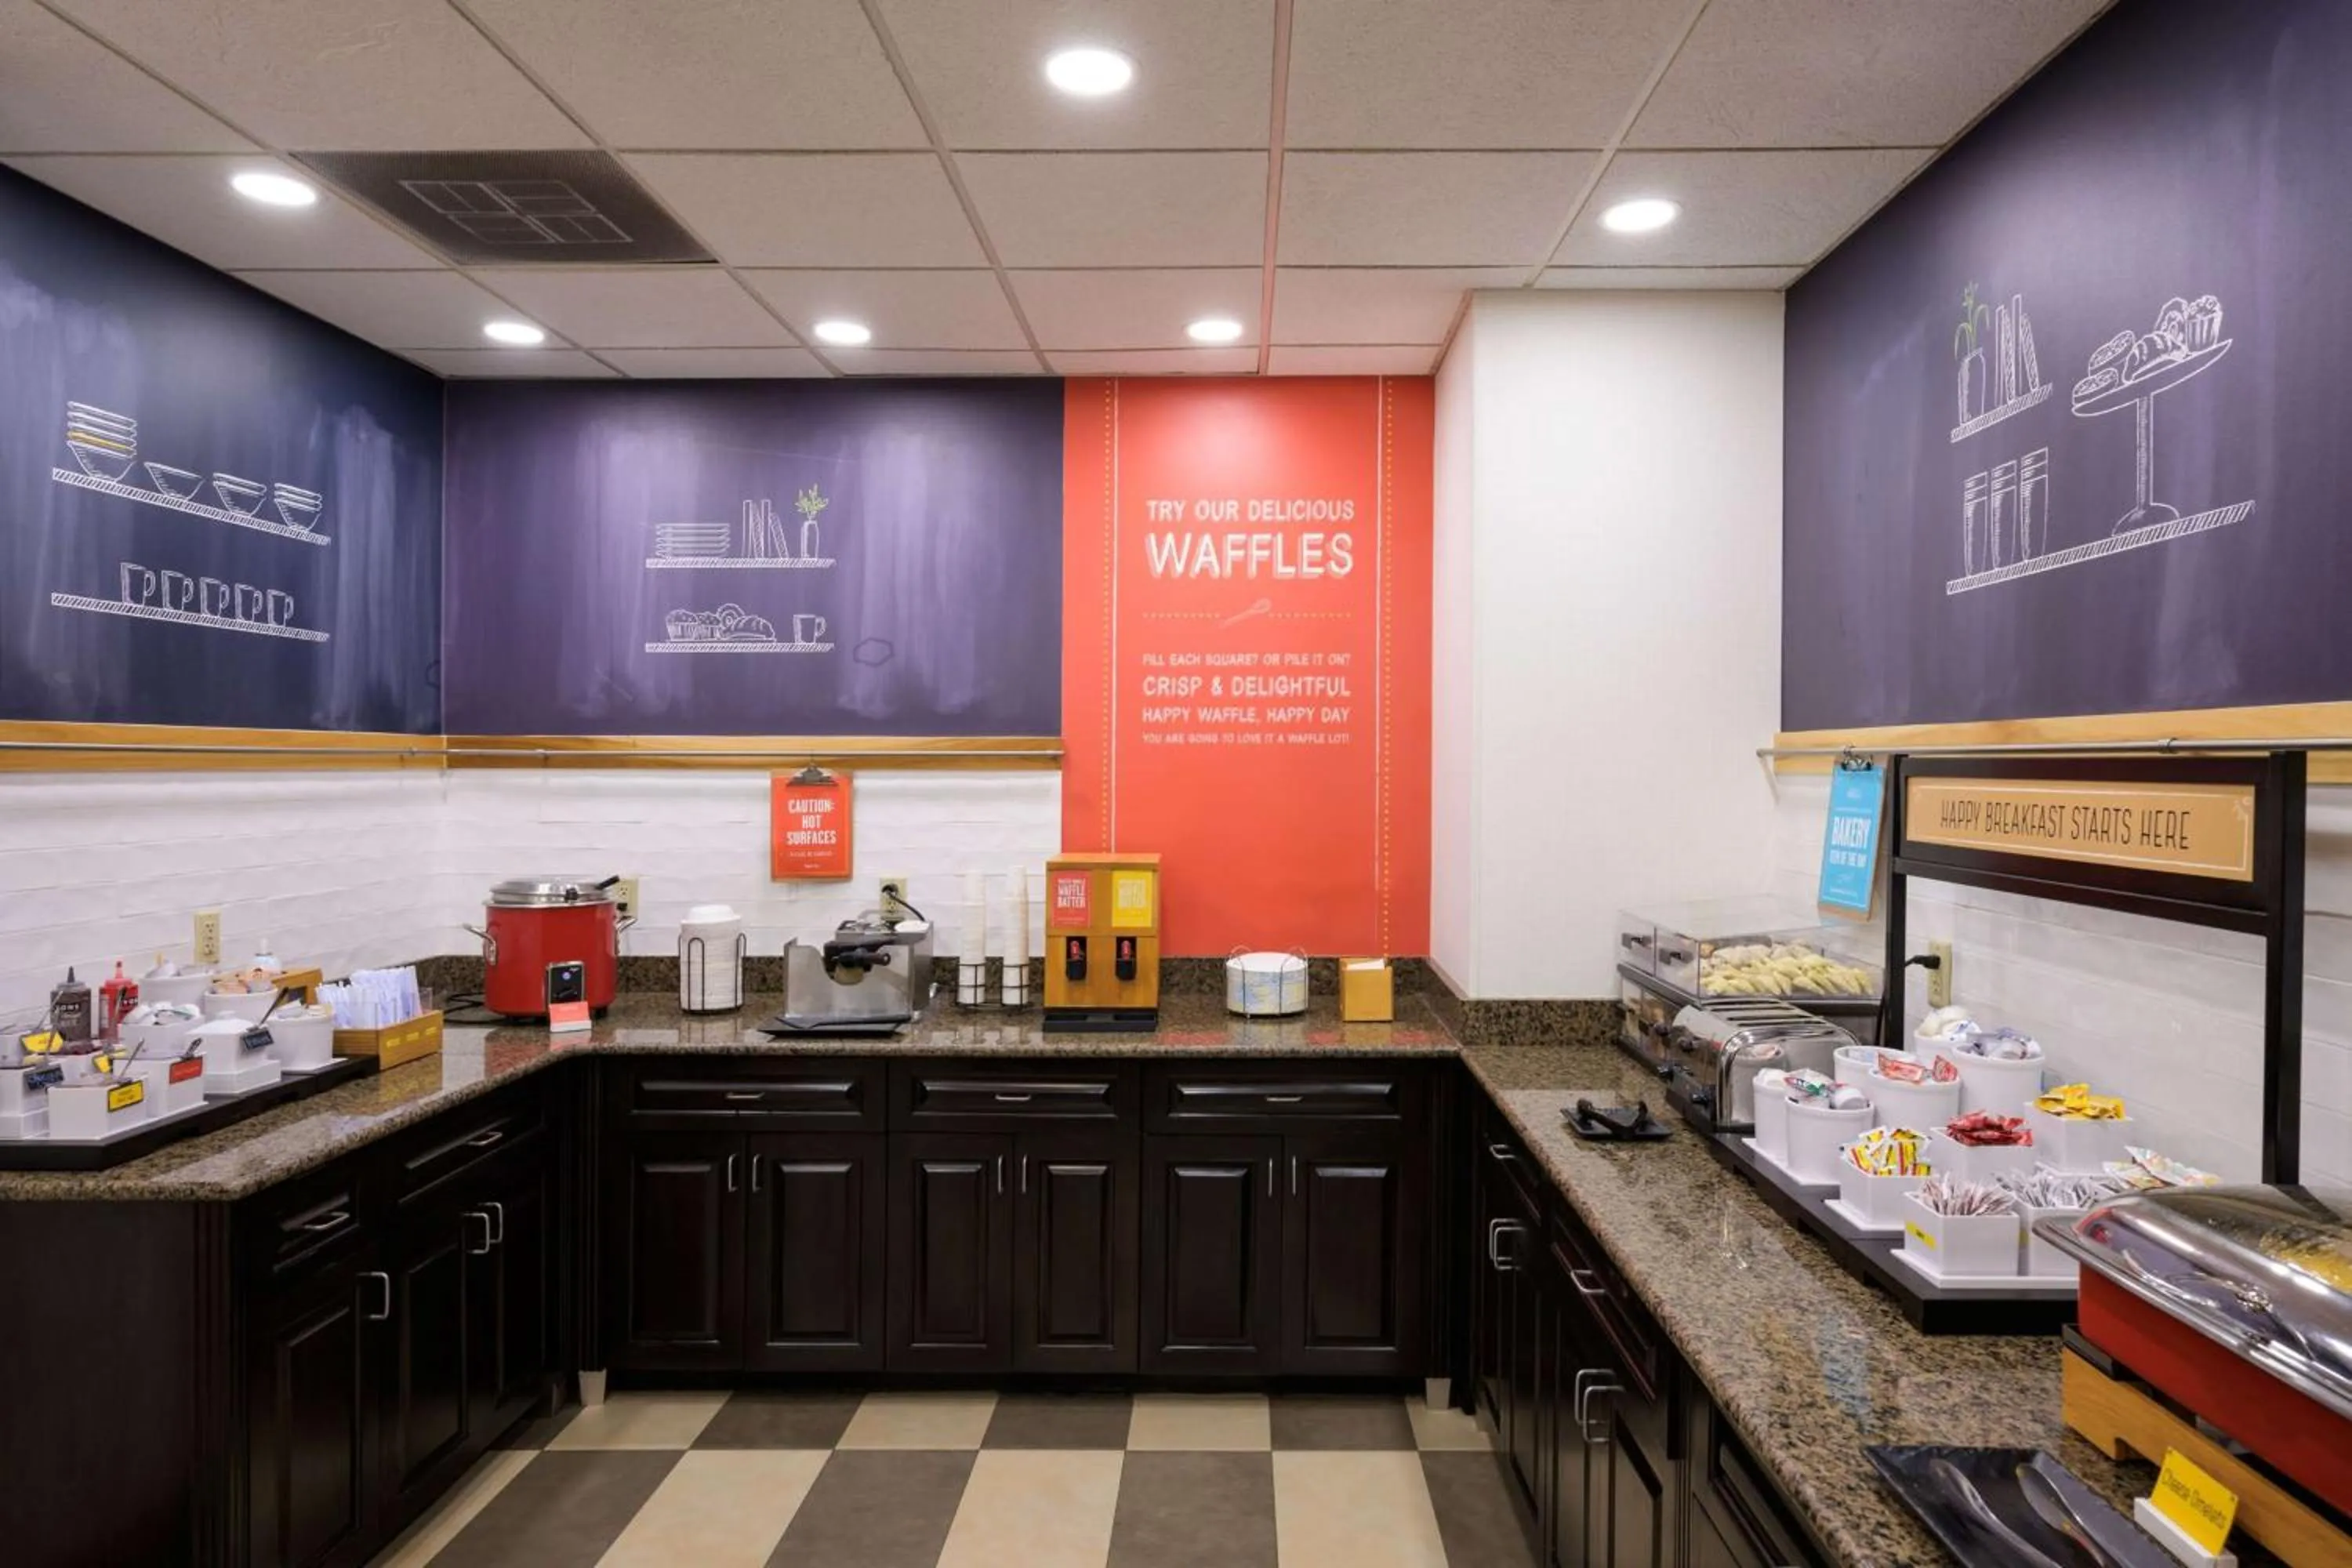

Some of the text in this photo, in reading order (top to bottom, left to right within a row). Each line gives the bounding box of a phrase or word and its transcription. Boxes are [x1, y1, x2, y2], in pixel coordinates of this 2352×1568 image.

[1147, 499, 1355, 521] TRY OUR DELICIOUS
[1145, 532, 1354, 579] WAFFLES
[1142, 653, 1164, 666] FILL
[1170, 652, 1201, 666] EACH
[1263, 653, 1280, 666] OR
[1284, 653, 1308, 666] PILE
[1312, 653, 1323, 666] IT
[1143, 675, 1351, 698] CRISP & DELIGHTFUL
[1142, 706, 1190, 723] HAPPY
[1267, 706, 1316, 723] HAPPY
[1321, 706, 1349, 723] DAY
[1142, 731, 1162, 744] YOU
[1222, 733, 1235, 744] TO
[1237, 733, 1261, 744] LOVE
[1265, 733, 1273, 744] IT
[1277, 733, 1284, 744] A
[1288, 733, 1326, 744] WAFFLE
[802, 815, 822, 828] HOT
[1940, 799, 2190, 850] HAPPY BREAKFAST STARTS HERE
[786, 831, 837, 845] SURFACES
[1831, 815, 1871, 849] BAKERY
[1058, 884, 1086, 896] WAFFLE
[1057, 896, 1086, 908] BATTER
